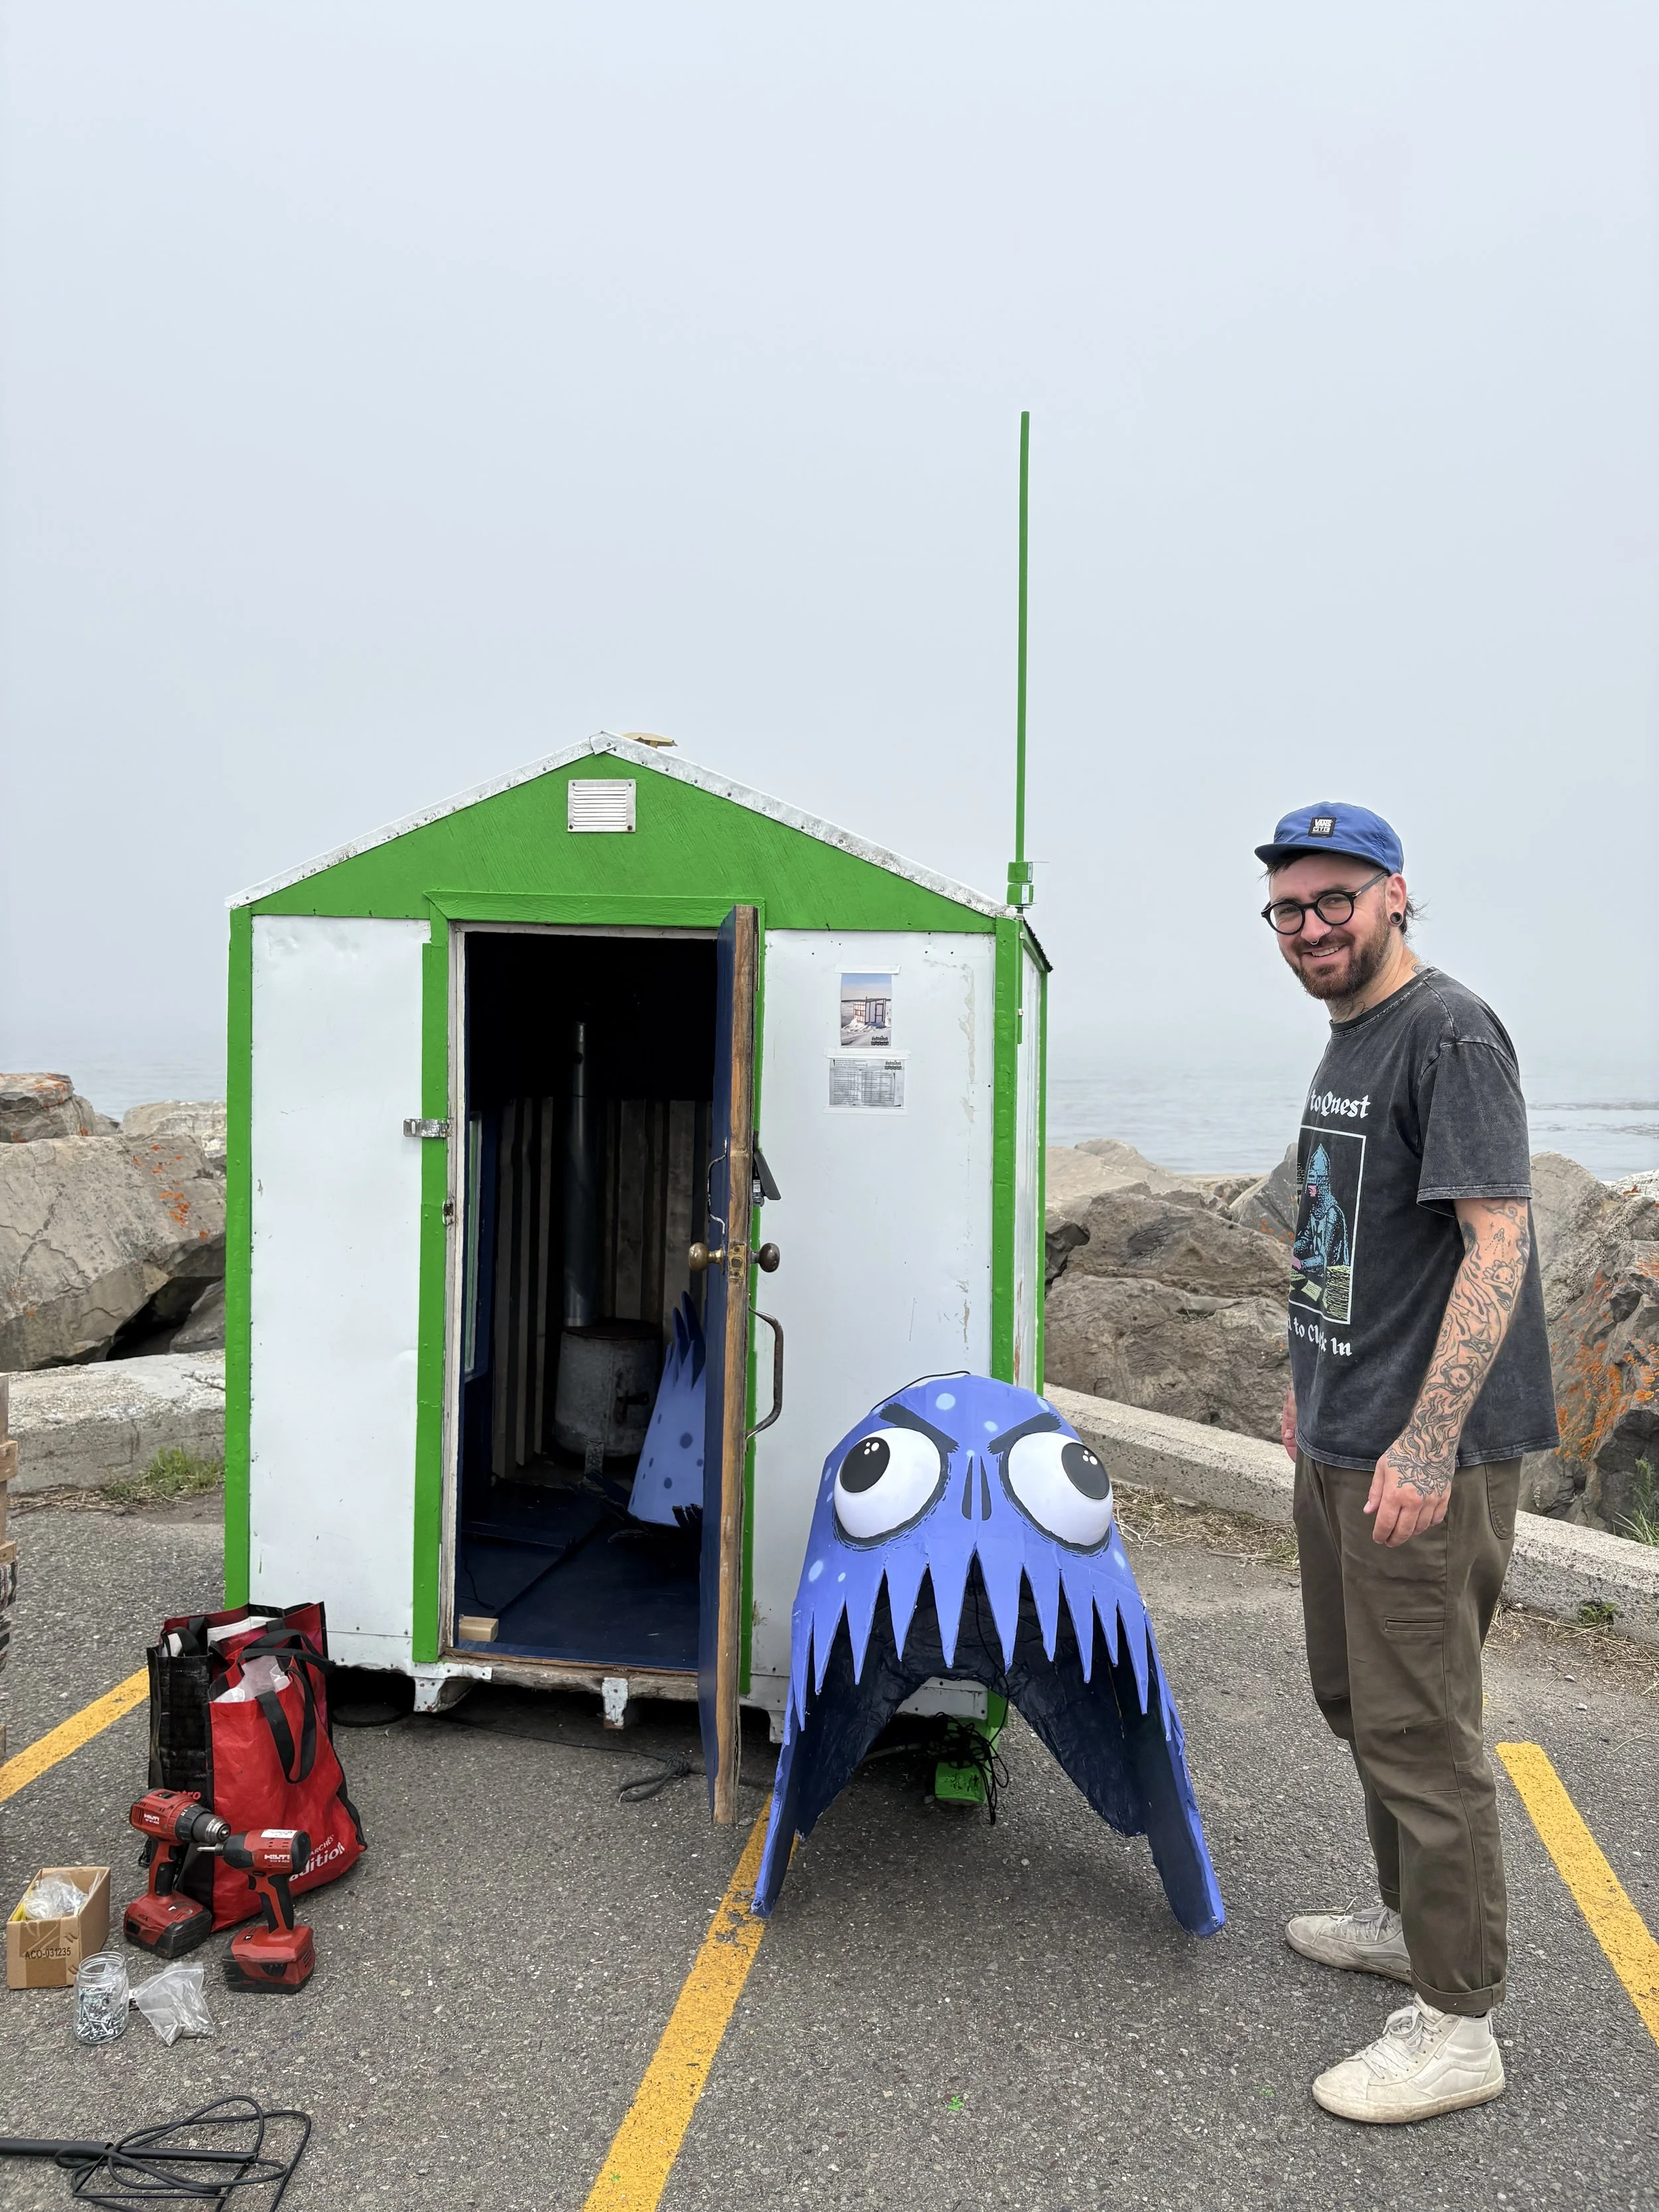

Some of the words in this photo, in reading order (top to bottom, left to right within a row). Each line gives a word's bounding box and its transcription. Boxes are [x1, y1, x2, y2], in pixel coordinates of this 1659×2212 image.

[1310, 1088, 1321, 1112] to
[1321, 1091, 1371, 1119] Quest
[1293, 1317, 1305, 1338] to
[1308, 1324, 1327, 1352] Clk
[1331, 1337, 1352, 1357] In
[25, 1947, 72, 1959] ACO-031235
